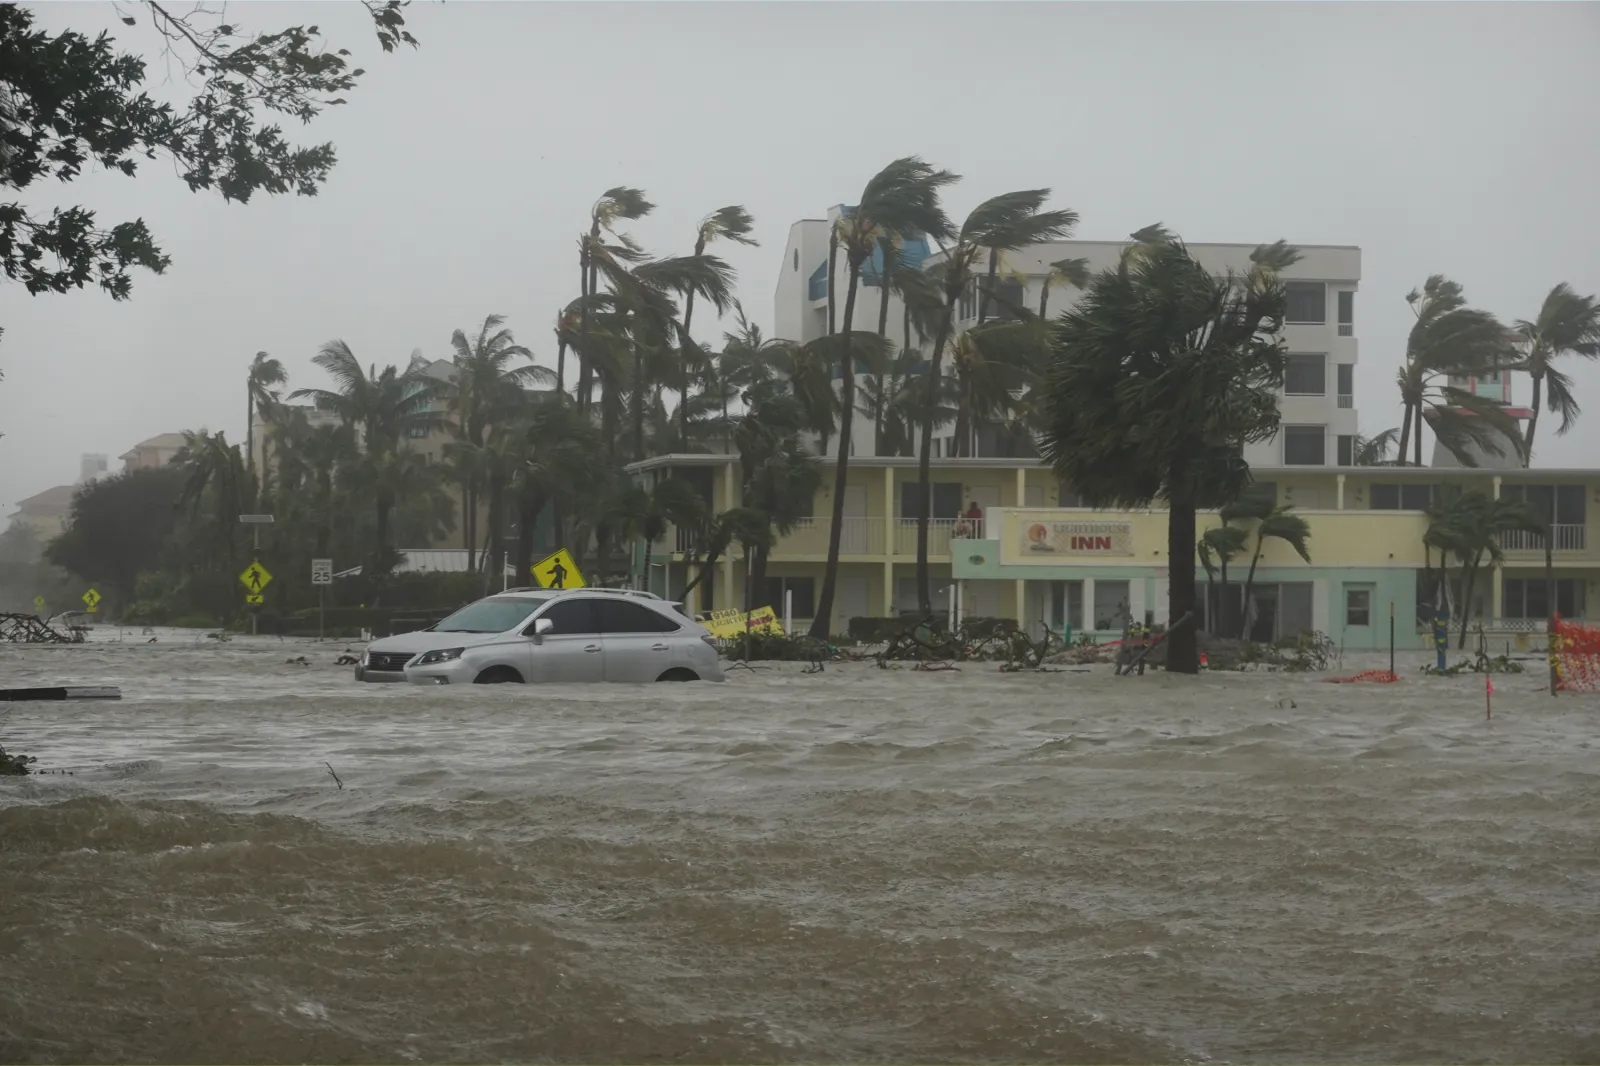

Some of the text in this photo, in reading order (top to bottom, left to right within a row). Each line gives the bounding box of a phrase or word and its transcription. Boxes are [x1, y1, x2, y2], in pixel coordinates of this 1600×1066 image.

[1071, 536, 1111, 550] INN
[313, 572, 330, 582] 25
[713, 609, 737, 619] 9140
